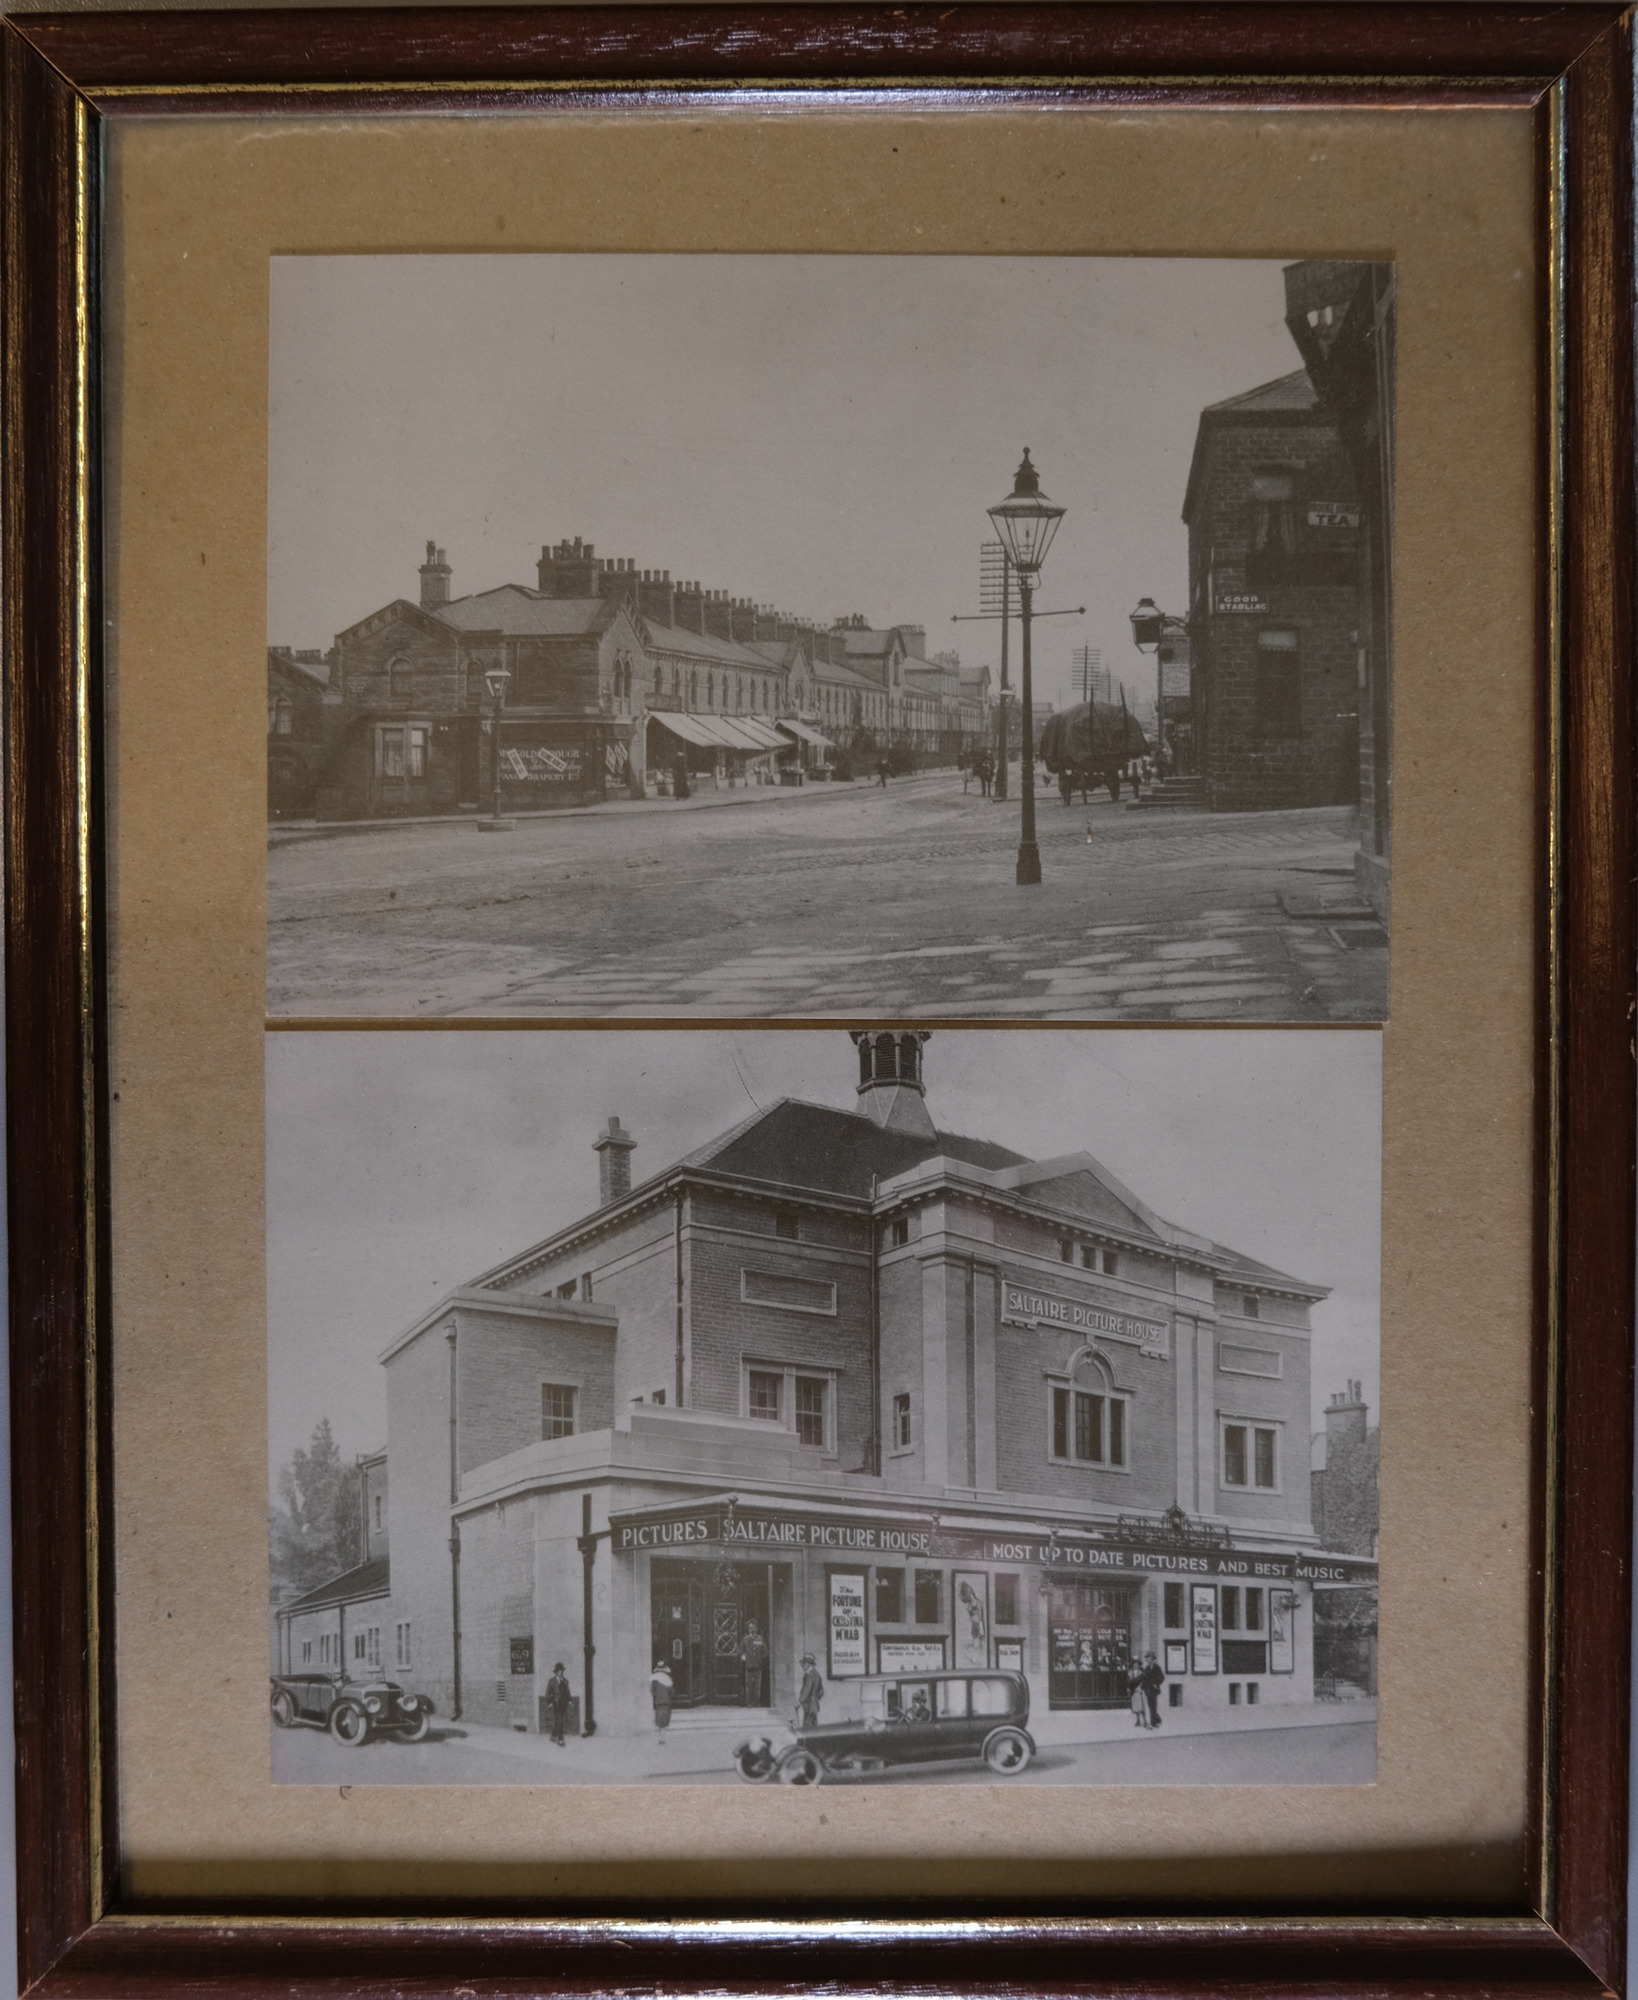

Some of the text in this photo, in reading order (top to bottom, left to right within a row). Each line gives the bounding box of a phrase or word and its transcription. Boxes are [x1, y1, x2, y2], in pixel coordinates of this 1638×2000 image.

[1315, 514, 1351, 527] TEA
[1009, 1292, 1161, 1343] SALTAIRE PICTURE HOUSE
[622, 1520, 708, 1547] PICTURES
[723, 1519, 806, 1543] SALTAIRE
[810, 1525, 876, 1547] PICTURE
[880, 1530, 929, 1550] HOUSE
[992, 1543, 1032, 1560] MOST
[1039, 1546, 1061, 1562] UP
[1064, 1547, 1084, 1563] TO
[1088, 1549, 1124, 1565] DATE
[1132, 1553, 1208, 1571] PICTURES
[1217, 1560, 1248, 1574] AND
[1254, 1562, 1288, 1576] BEST
[1295, 1566, 1345, 1580] MUSIC
[832, 1594, 862, 1607] FORTUNE
